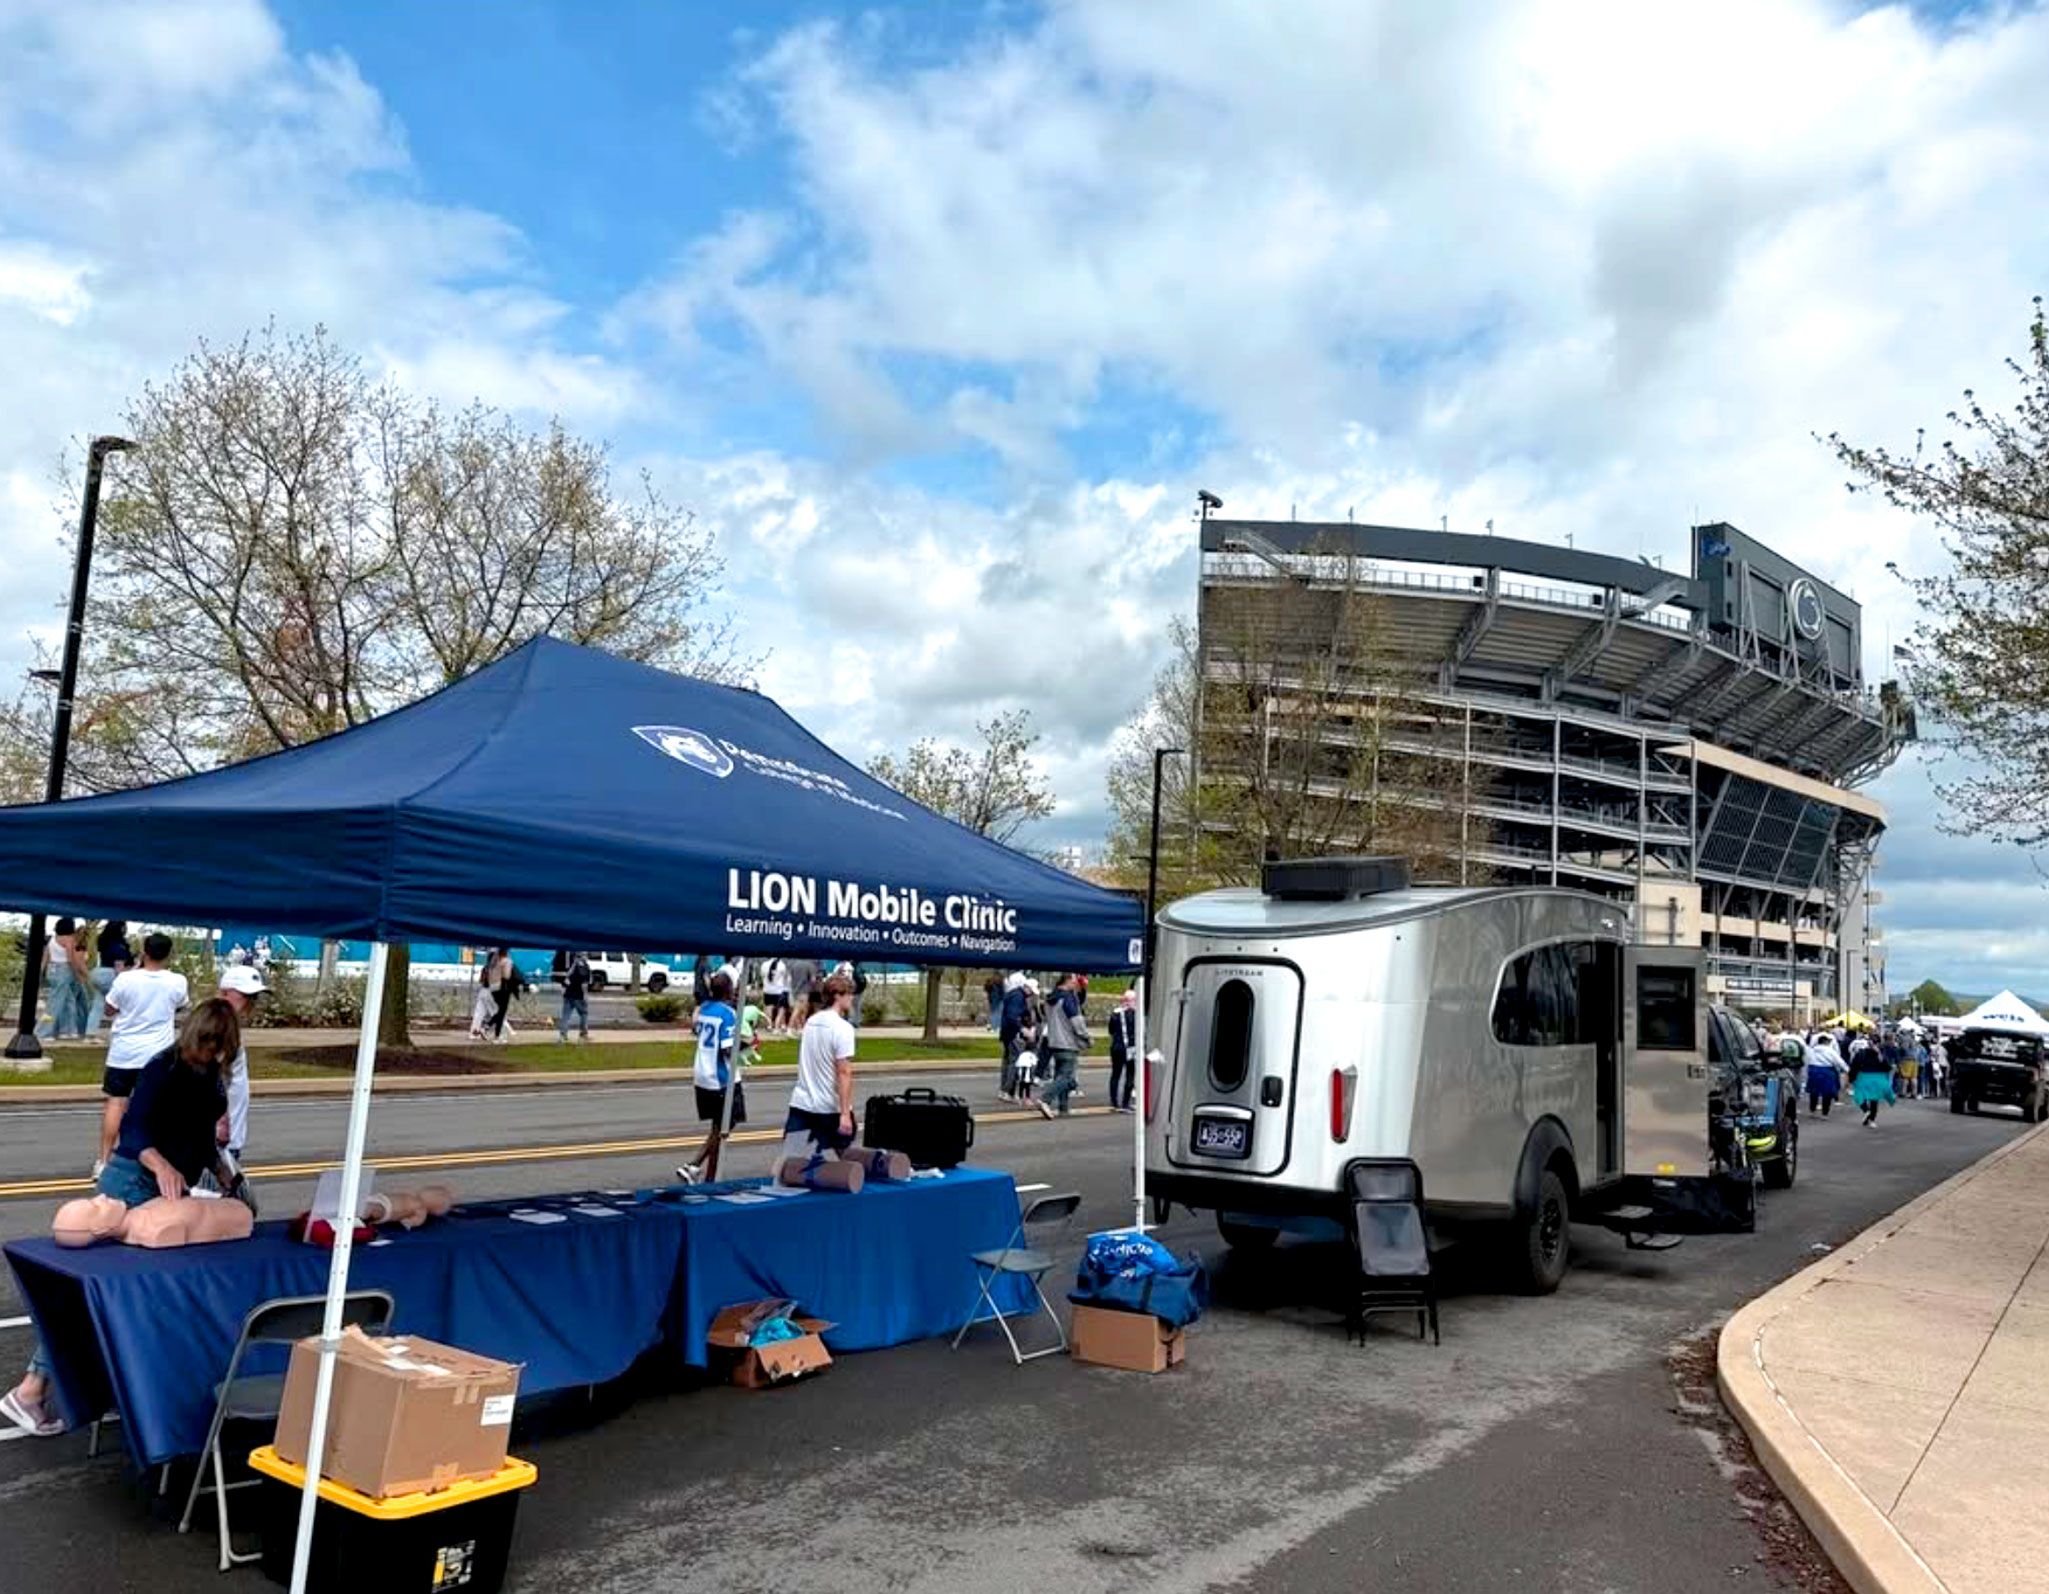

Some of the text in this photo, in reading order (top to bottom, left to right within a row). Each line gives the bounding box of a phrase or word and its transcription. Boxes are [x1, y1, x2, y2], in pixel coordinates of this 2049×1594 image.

[728, 868, 1017, 933] LION Mobile Clinic
[726, 913, 1016, 954] Learning Innovation Outcomes Navigation
